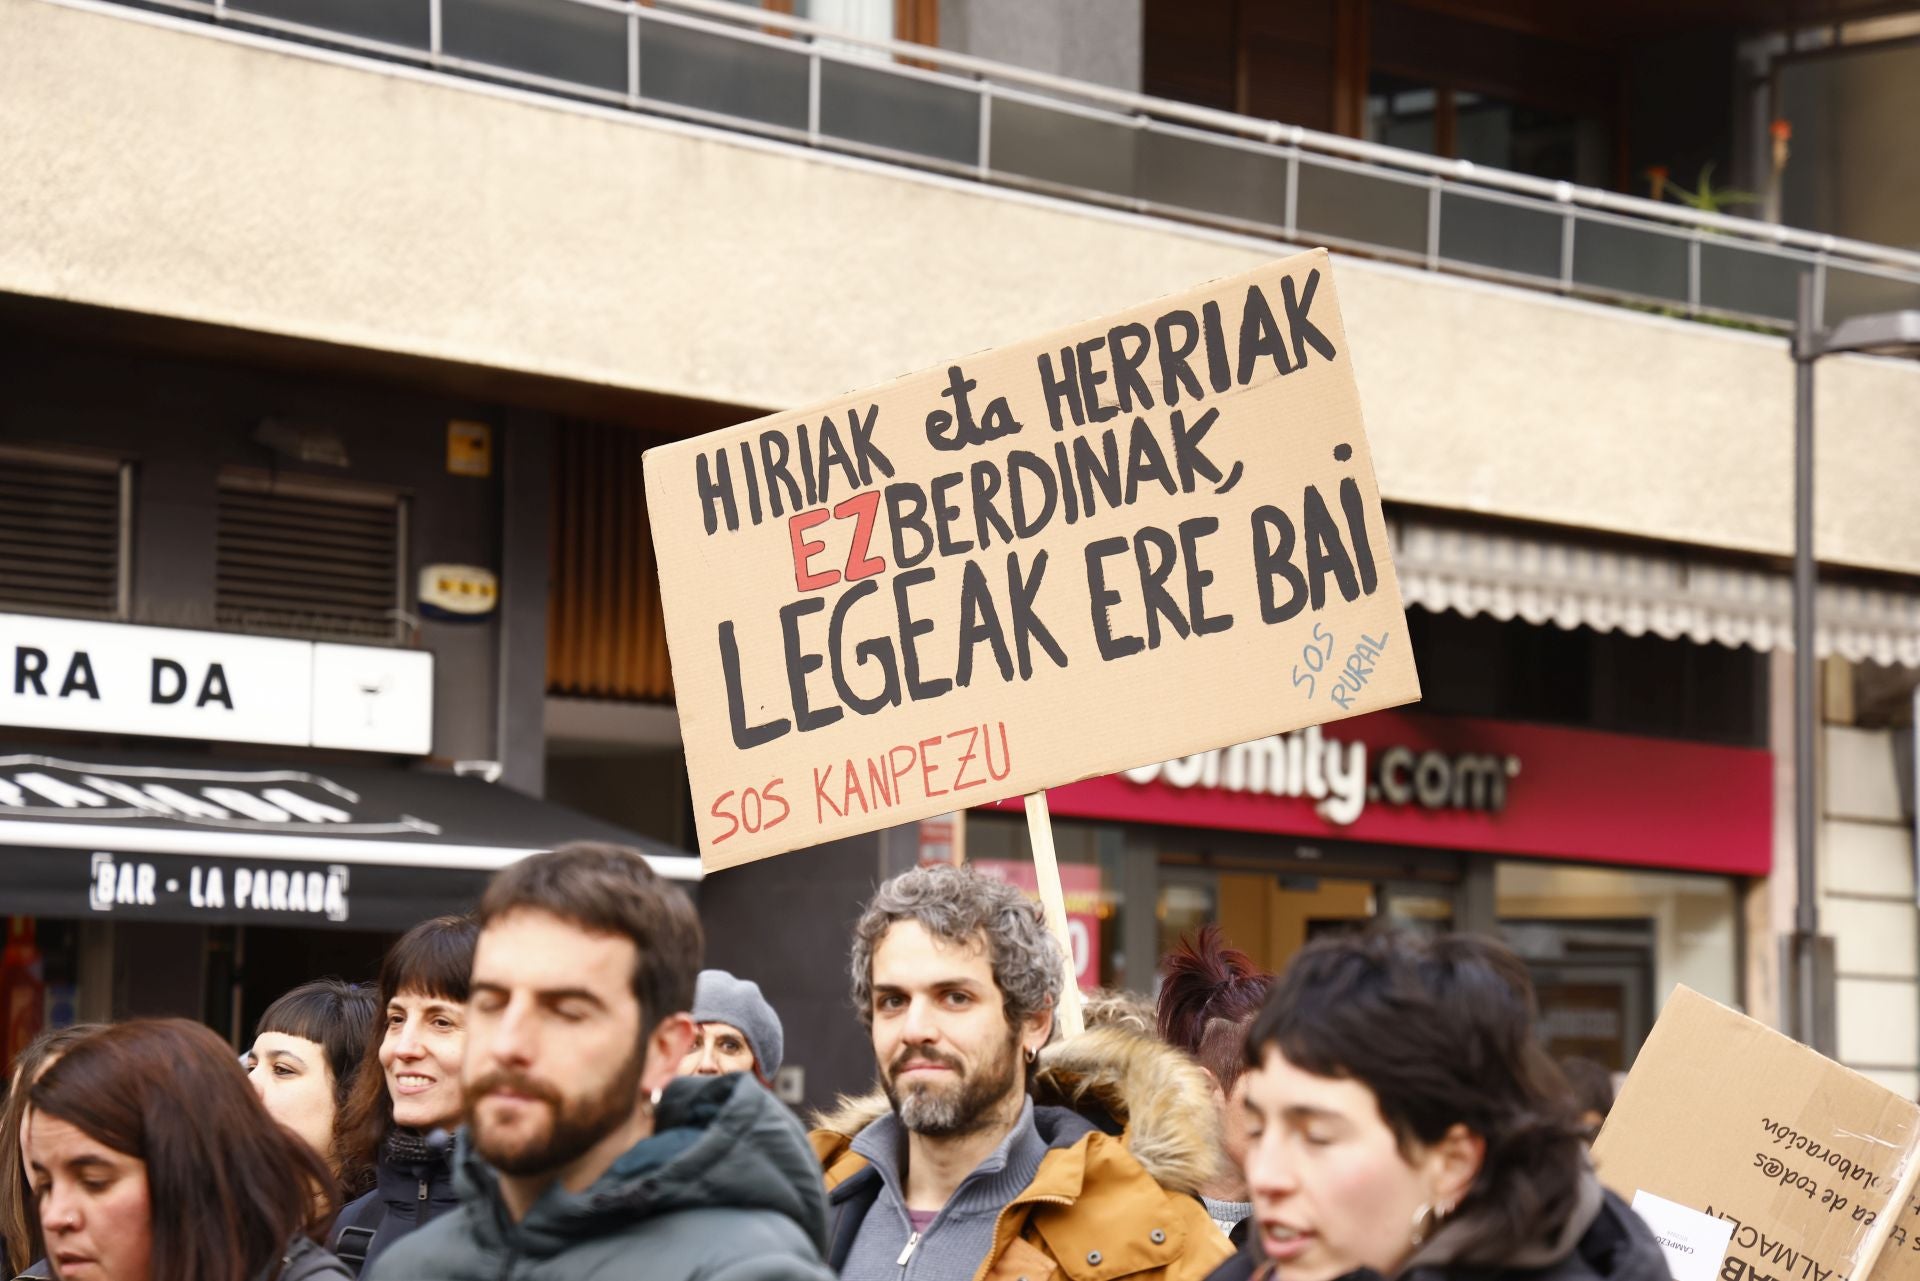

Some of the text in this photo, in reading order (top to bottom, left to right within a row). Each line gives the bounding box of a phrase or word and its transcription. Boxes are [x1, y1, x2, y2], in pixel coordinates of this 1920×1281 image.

[696, 268, 1337, 535] HIRIAK eta HERRIAK
[718, 548, 1068, 750] LEGEAK
[1085, 516, 1234, 661] ERE
[1293, 622, 1334, 698] SOS
[1331, 632, 1389, 709] RURAL
[711, 722, 1011, 845] SOS KANPEZU
[97, 862, 343, 915] BAR LA PARADA
[1753, 1152, 1818, 1200] tod@s
[1821, 1188, 1848, 1213] de
